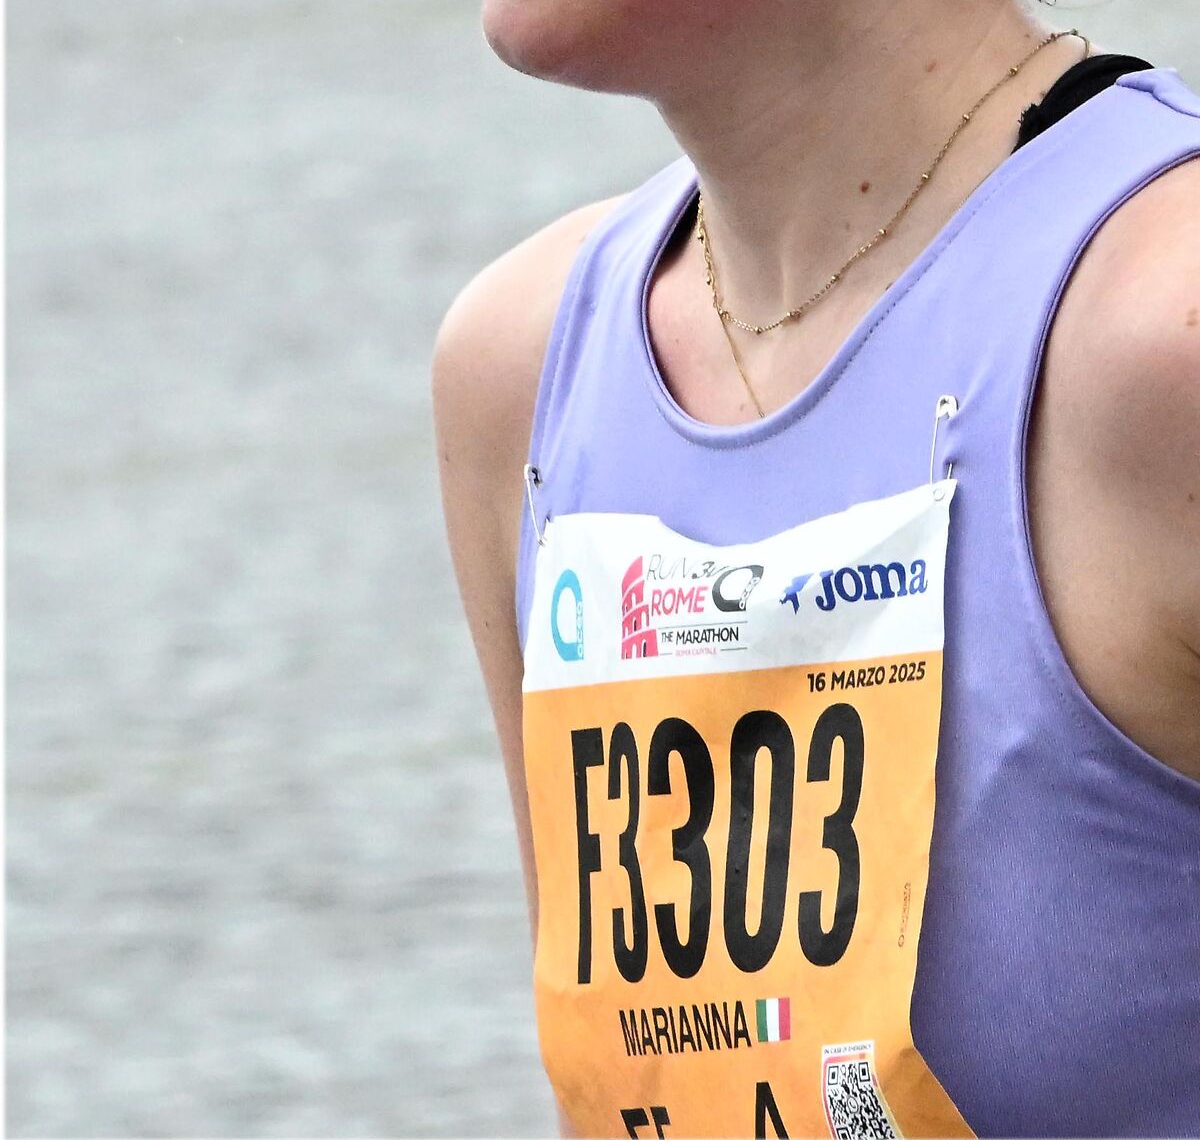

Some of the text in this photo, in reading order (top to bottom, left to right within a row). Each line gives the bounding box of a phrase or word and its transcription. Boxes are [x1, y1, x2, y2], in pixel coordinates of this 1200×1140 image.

[651, 586, 709, 616] ROME
[661, 626, 739, 645] THE MARATHON
[807, 661, 927, 692] 16 MARZO 2025
[571, 703, 865, 985] F3303
[619, 1000, 752, 1057] MARIANNA
